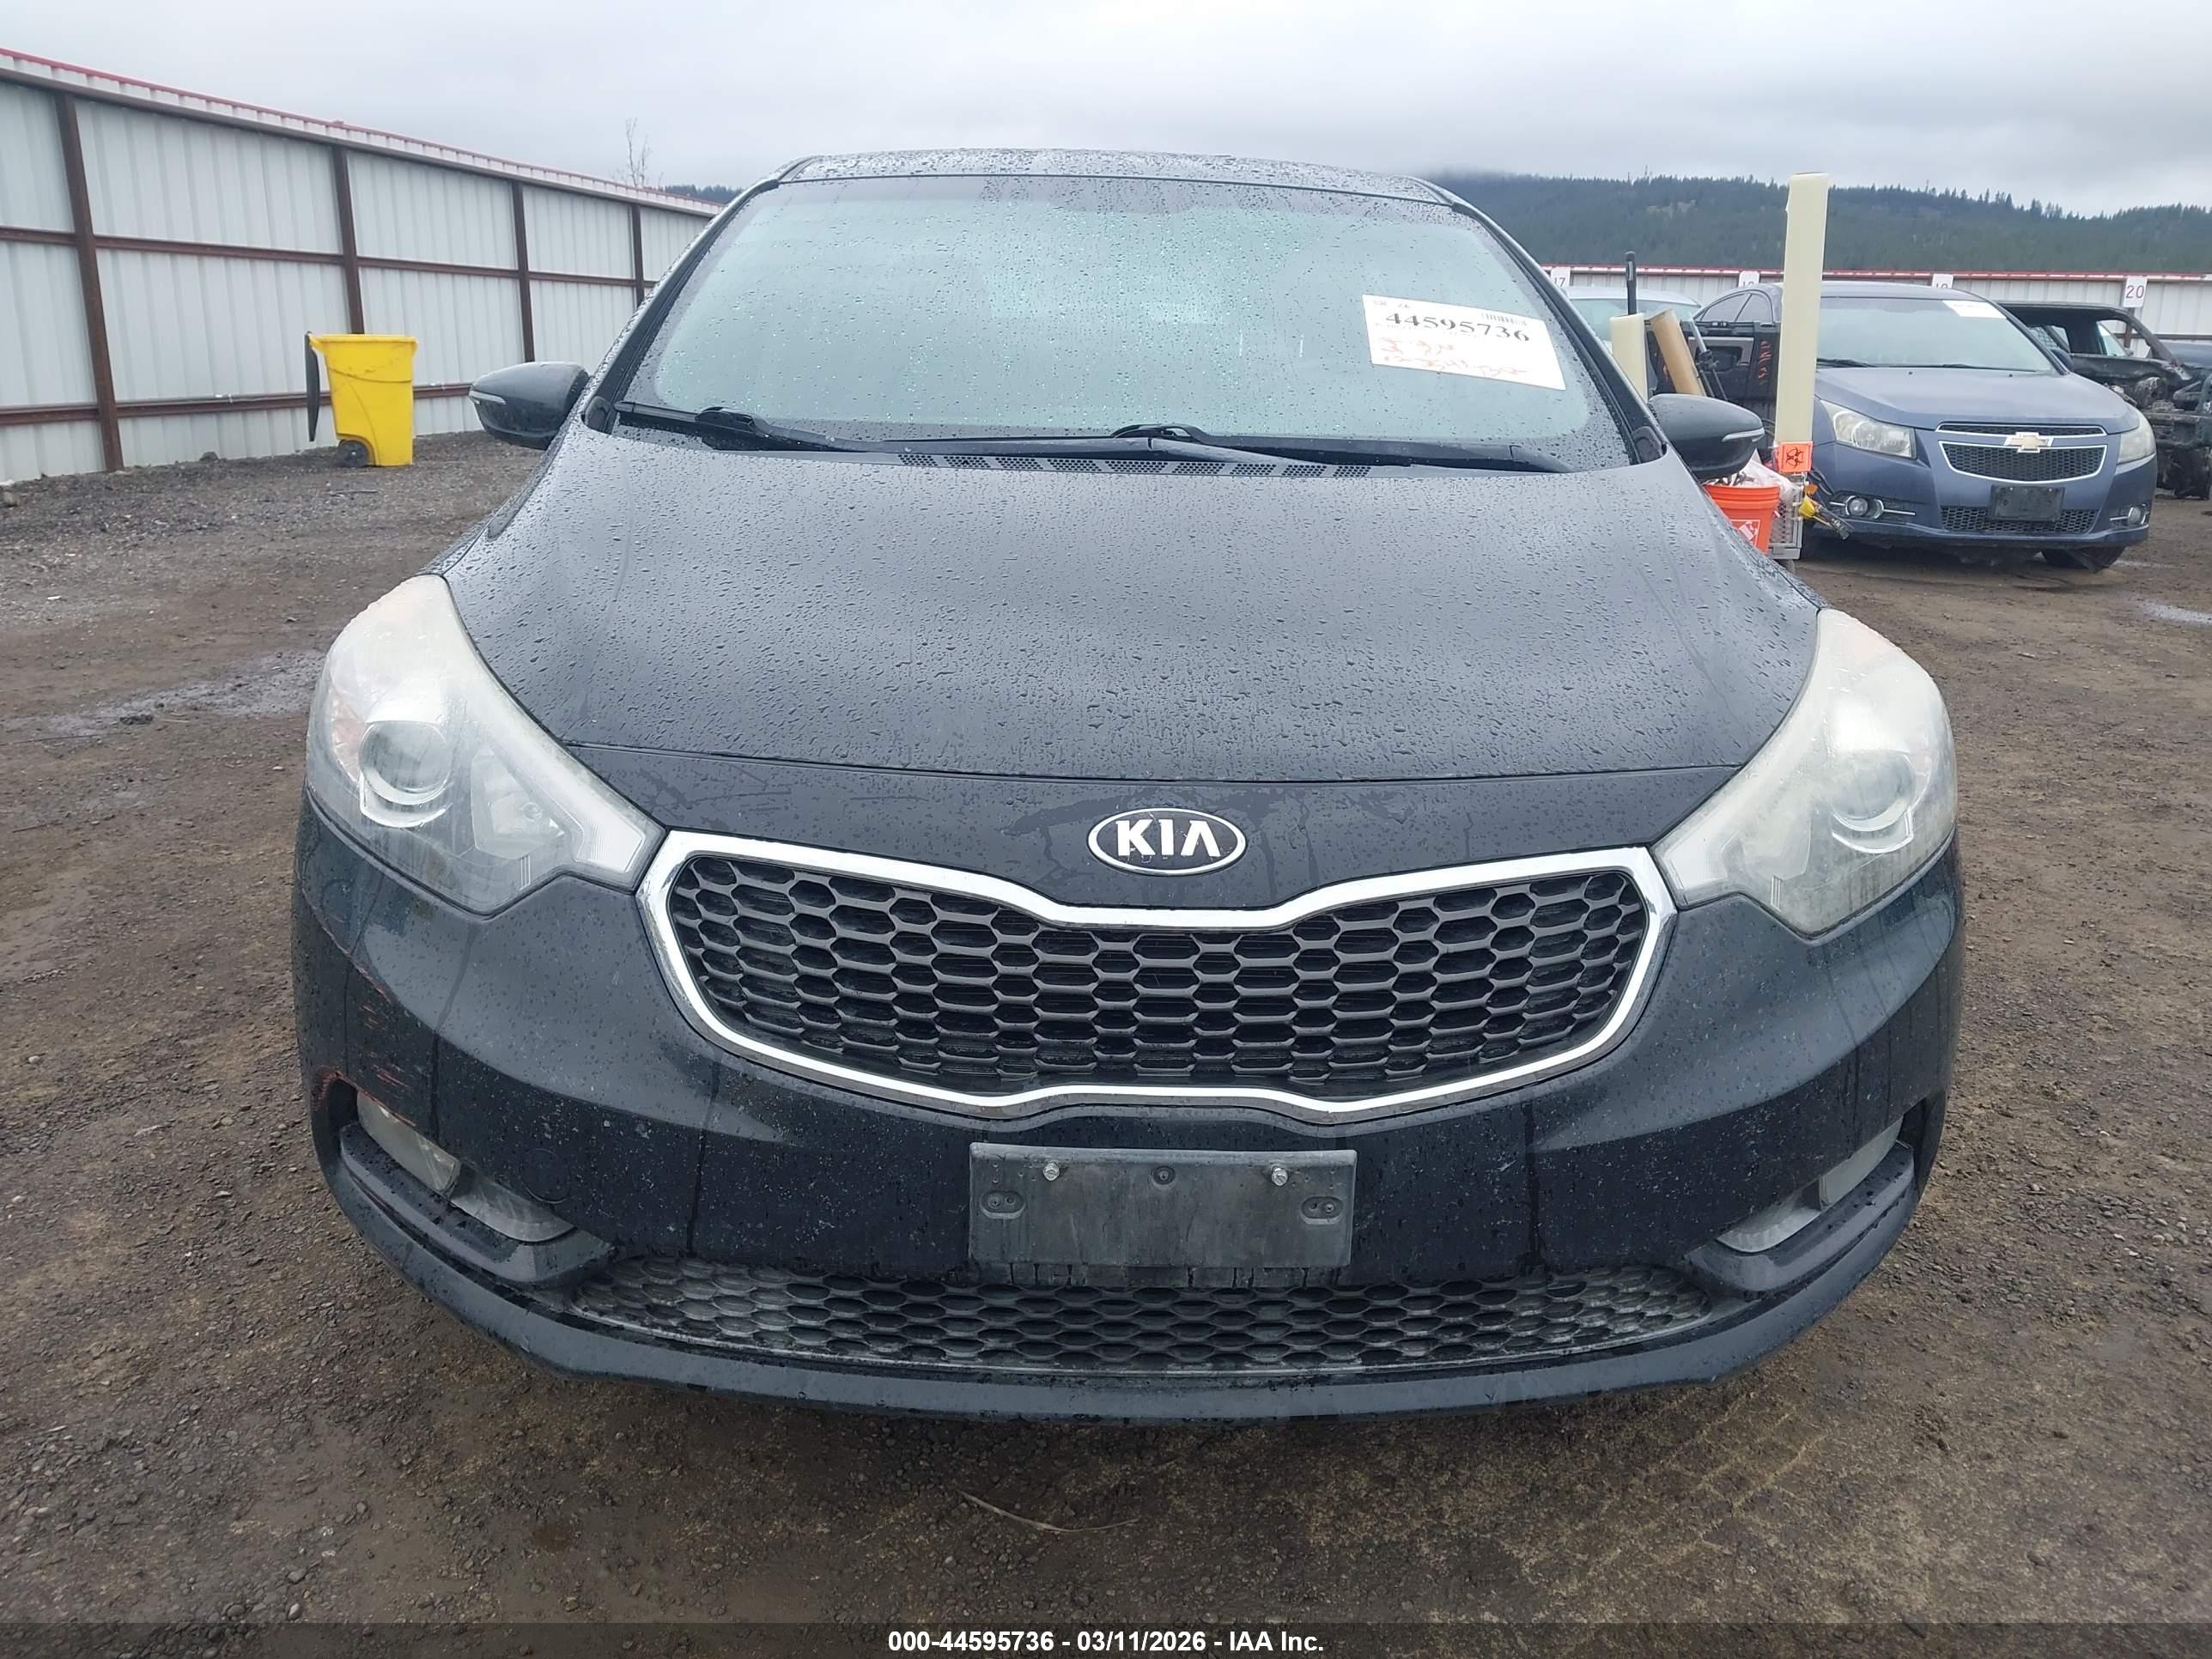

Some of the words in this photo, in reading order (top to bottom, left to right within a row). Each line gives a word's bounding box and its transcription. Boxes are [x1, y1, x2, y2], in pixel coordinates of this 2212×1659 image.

[2125, 284, 2145, 299] 20
[1385, 313, 1530, 342] 44595736
[1115, 818, 1221, 858] KIA
